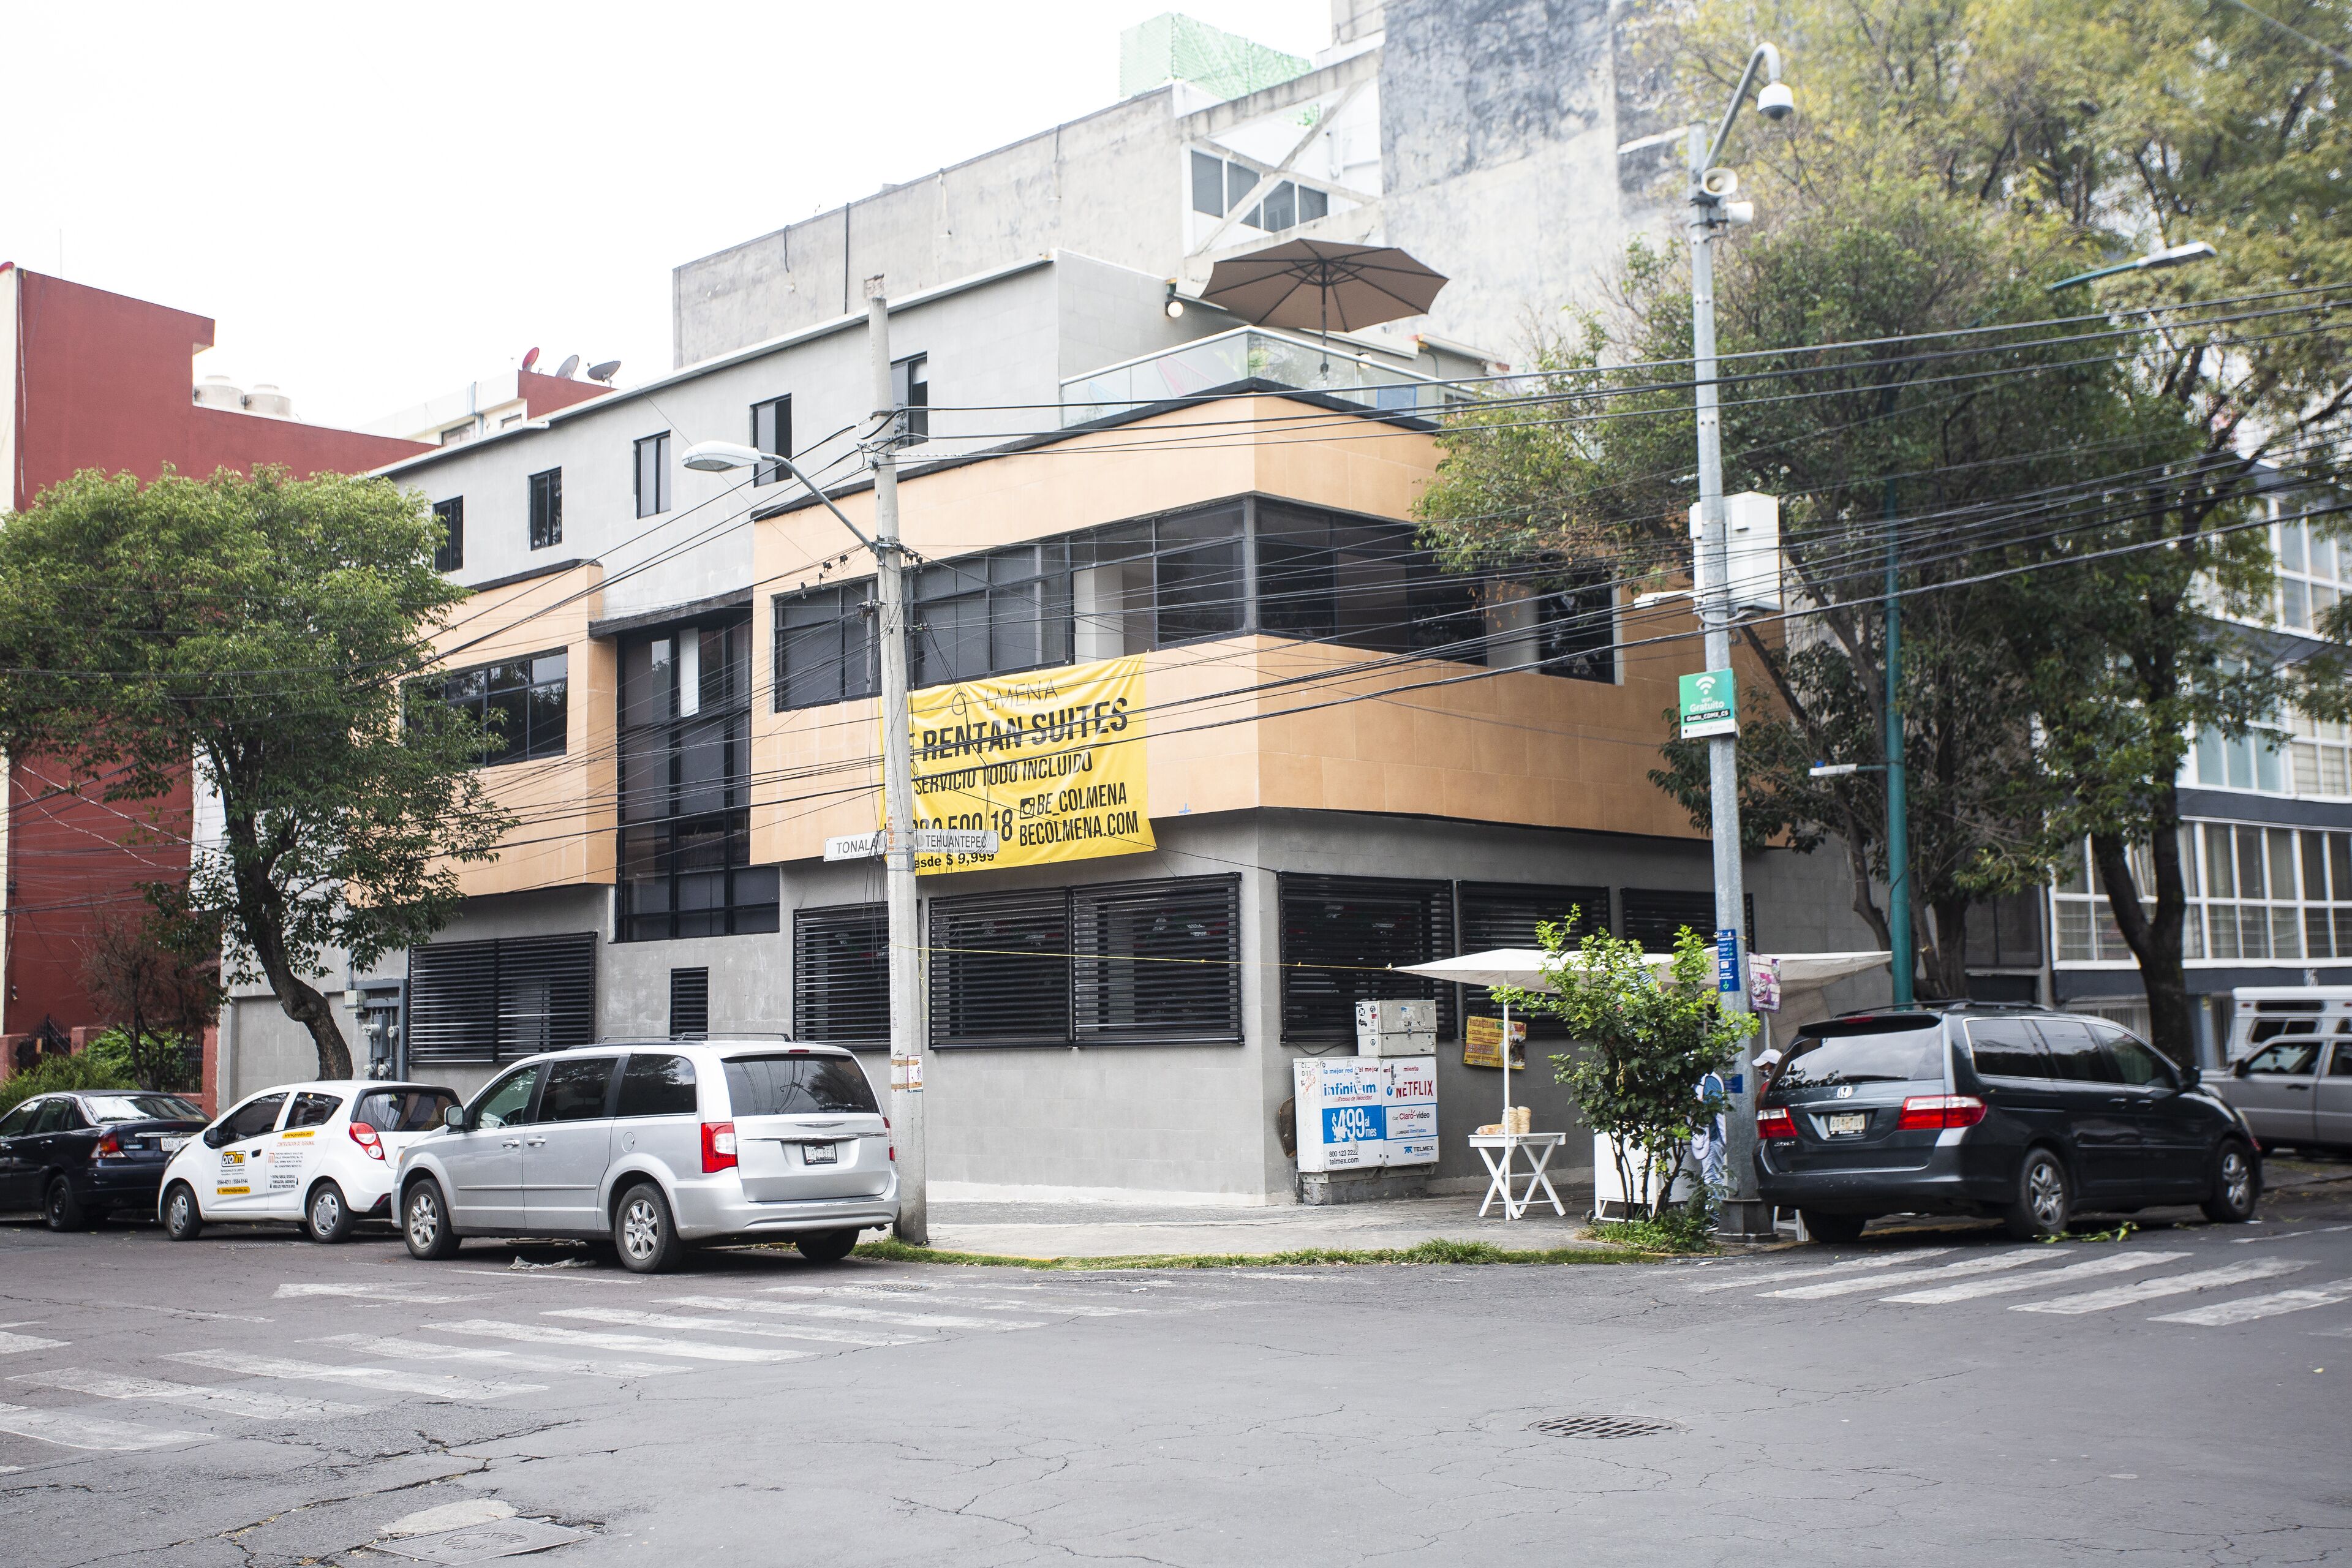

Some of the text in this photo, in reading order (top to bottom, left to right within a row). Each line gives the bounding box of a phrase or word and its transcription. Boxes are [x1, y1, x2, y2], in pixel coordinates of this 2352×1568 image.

[1689, 701, 1725, 713] Gratuito
[922, 716, 1023, 761] RENTAN
[1031, 697, 1128, 745] SUITES
[915, 751, 1093, 796] SERVICIO TODO INCLUIDO
[1037, 782, 1128, 816] BE_COLMENA
[1019, 810, 1139, 846] BECOLMENA.COM
[925, 835, 987, 848] TEHUANTEPEC
[914, 853, 995, 869] esde $ 9,999
[1395, 1080, 1433, 1099] NETFLIX
[1365, 1115, 1370, 1128] al
[1365, 1128, 1378, 1137] mes
[1329, 1157, 1359, 1166] telmex.com
